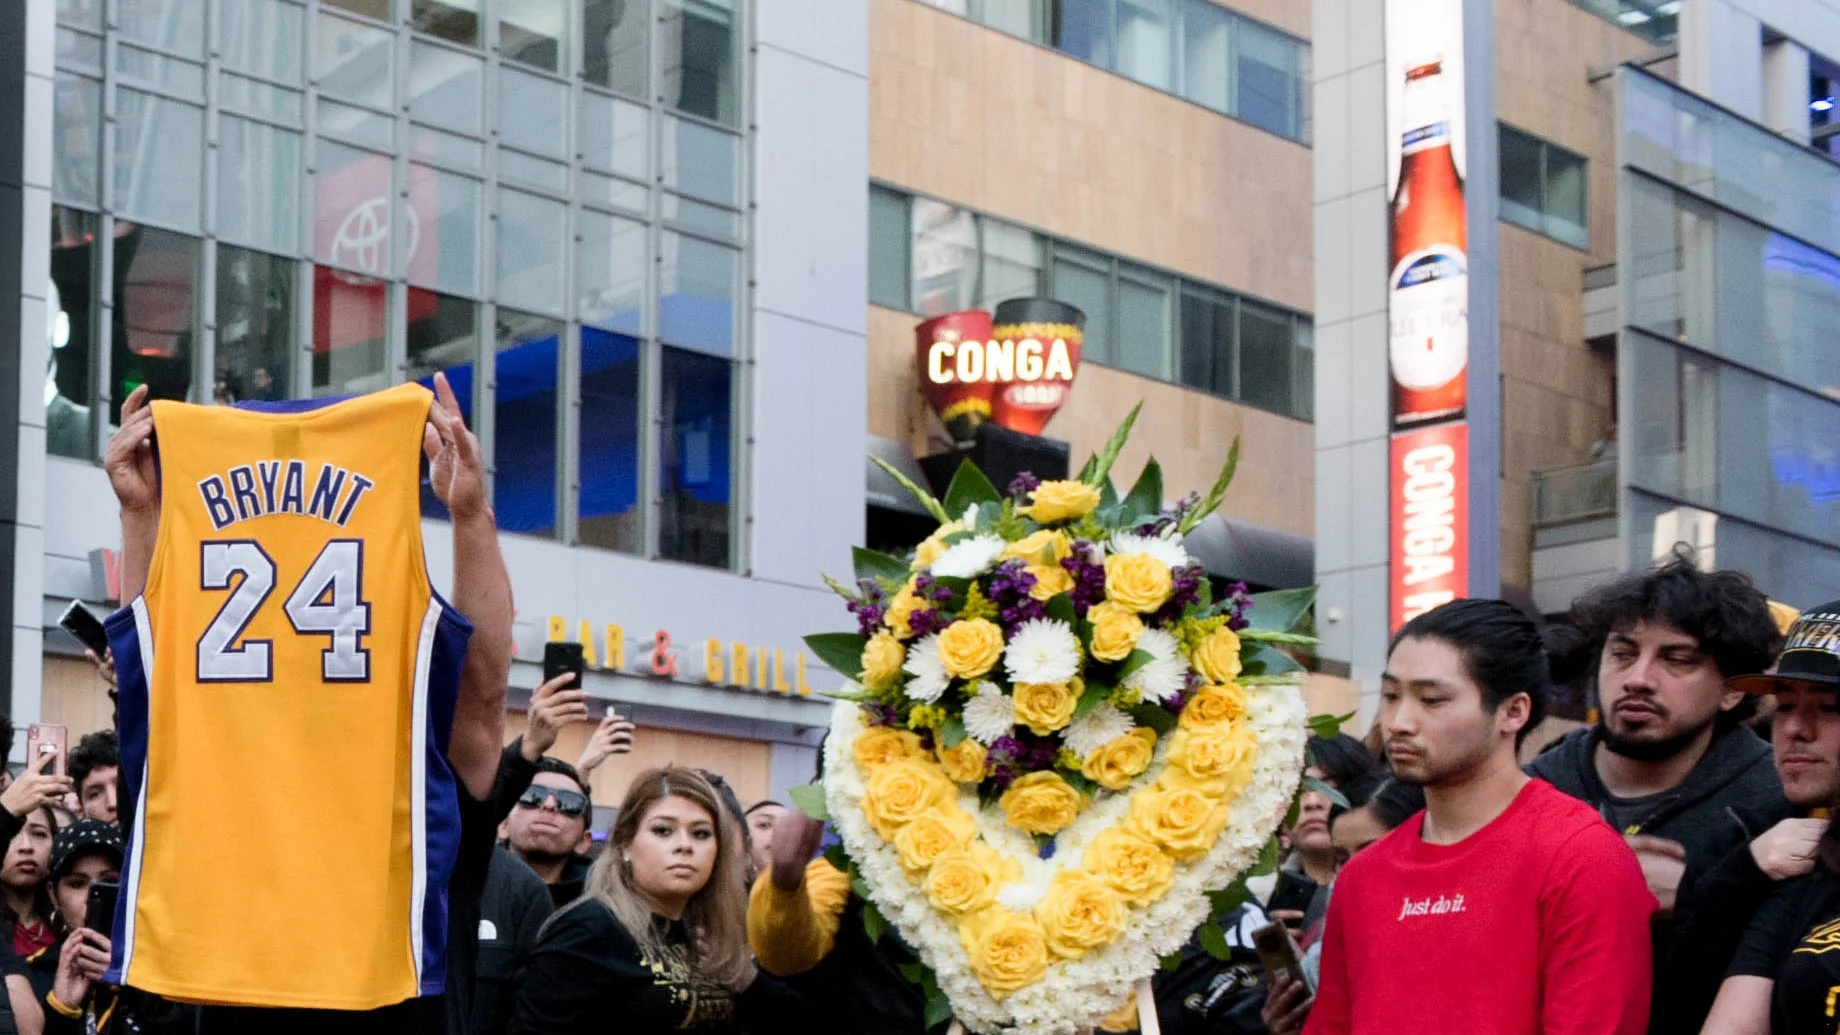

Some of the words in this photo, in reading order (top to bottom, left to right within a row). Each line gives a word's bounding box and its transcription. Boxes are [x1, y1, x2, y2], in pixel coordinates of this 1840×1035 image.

[927, 337, 1075, 385] CONGA
[197, 458, 375, 531] BRYANT
[1402, 443, 1455, 586] CONGA
[196, 538, 373, 683] 24
[651, 627, 681, 678] &
[705, 637, 812, 697] GRILL
[1397, 896, 1430, 921] Just
[1430, 894, 1452, 914] do
[1451, 892, 1467, 912] it.
